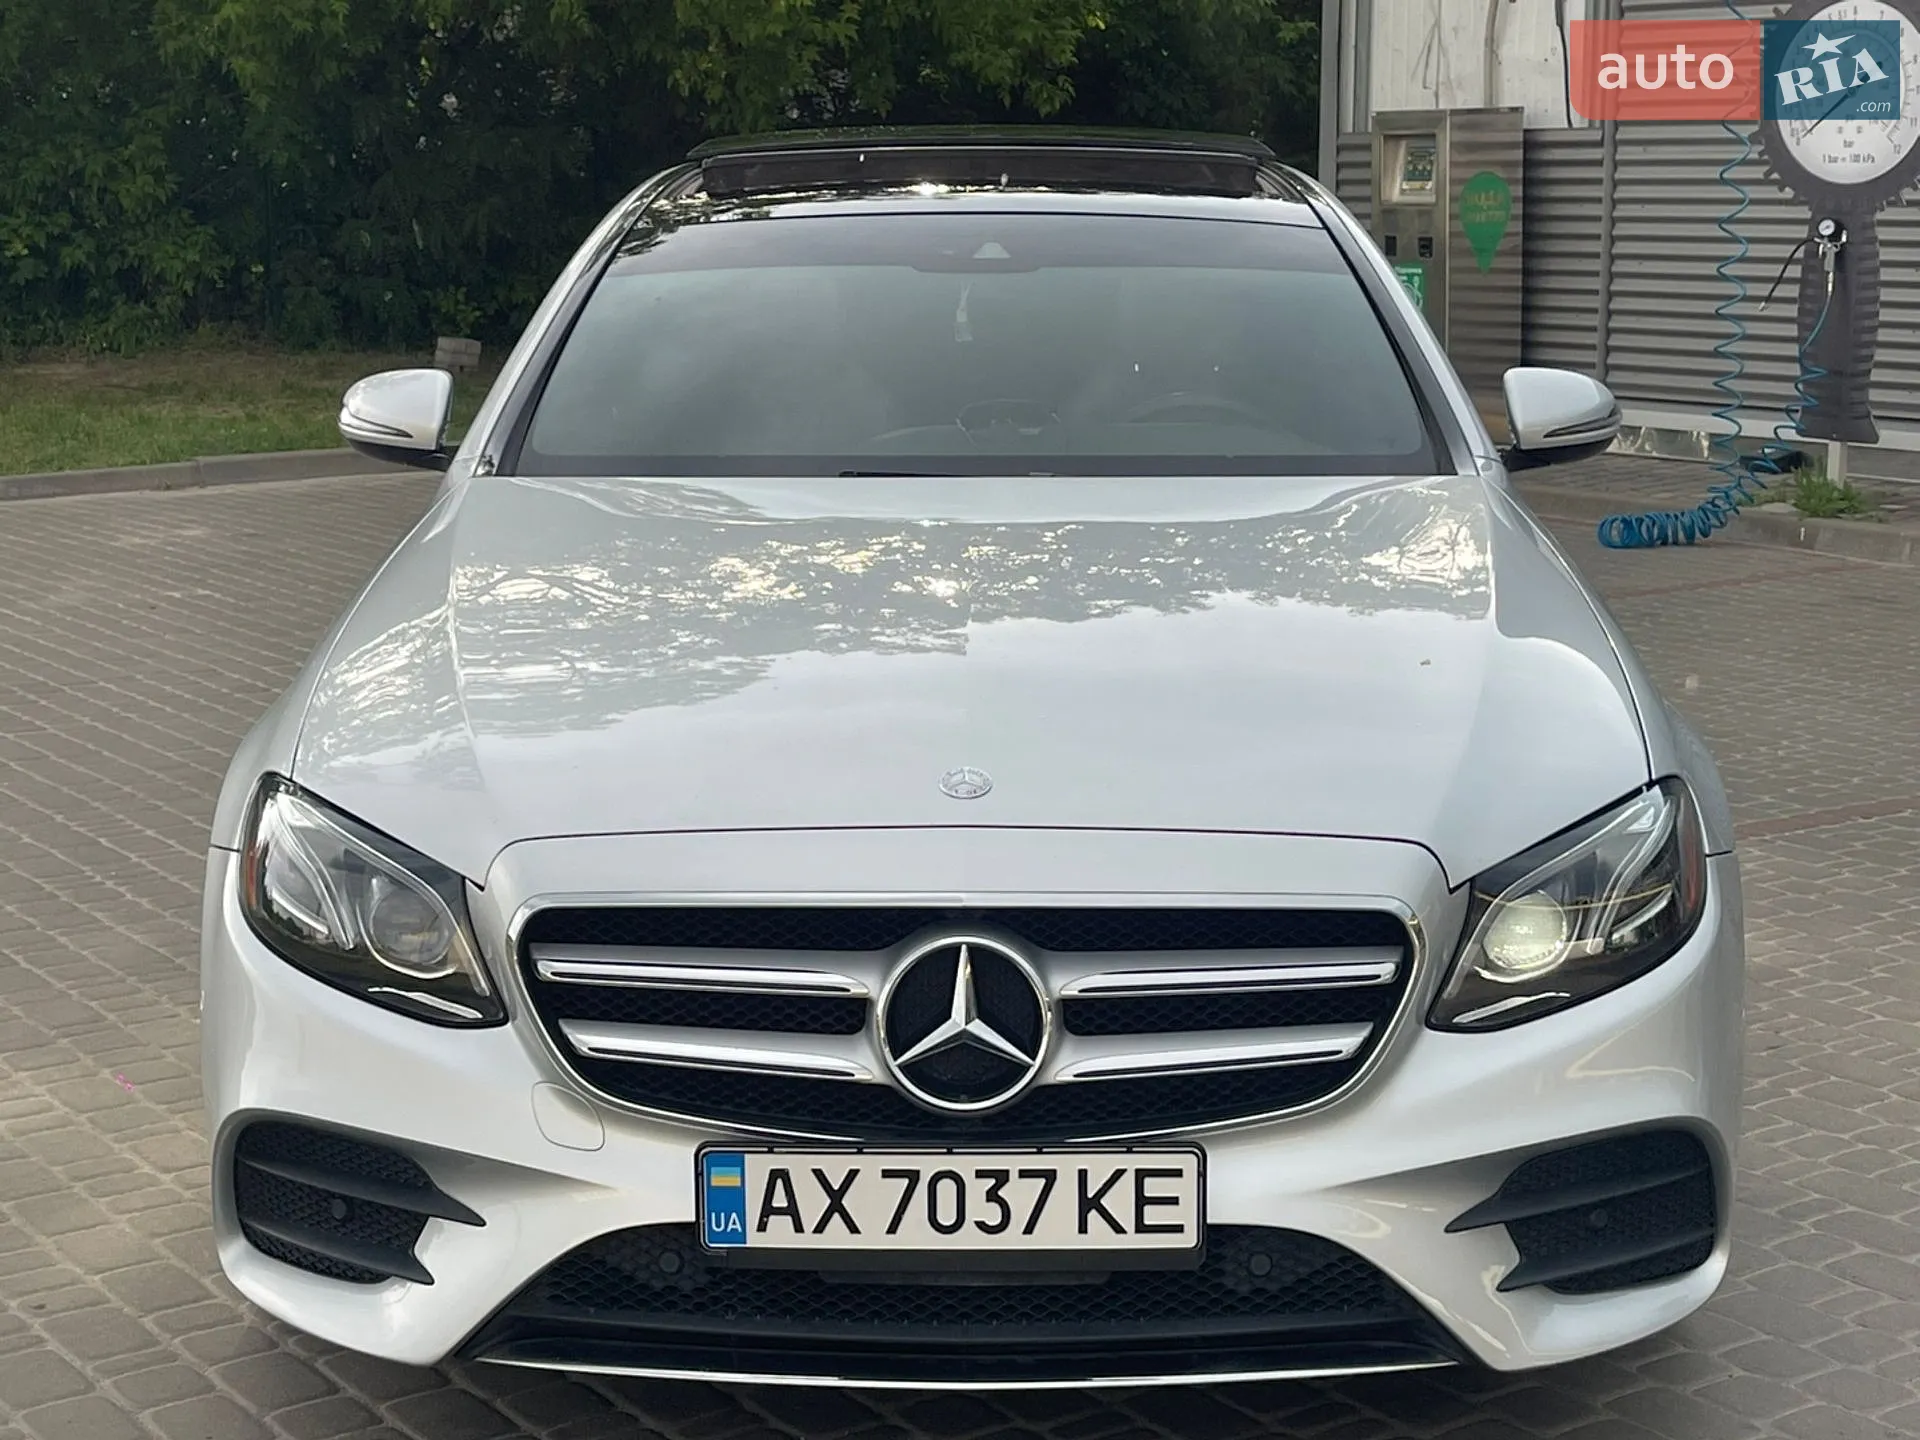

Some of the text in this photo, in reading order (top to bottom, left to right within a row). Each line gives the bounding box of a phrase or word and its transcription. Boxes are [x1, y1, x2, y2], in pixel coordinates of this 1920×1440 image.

[1893, 144, 1902, 155] 12
[756, 1168, 1185, 1236] AX 7037 KE
[711, 1212, 742, 1232] UA
